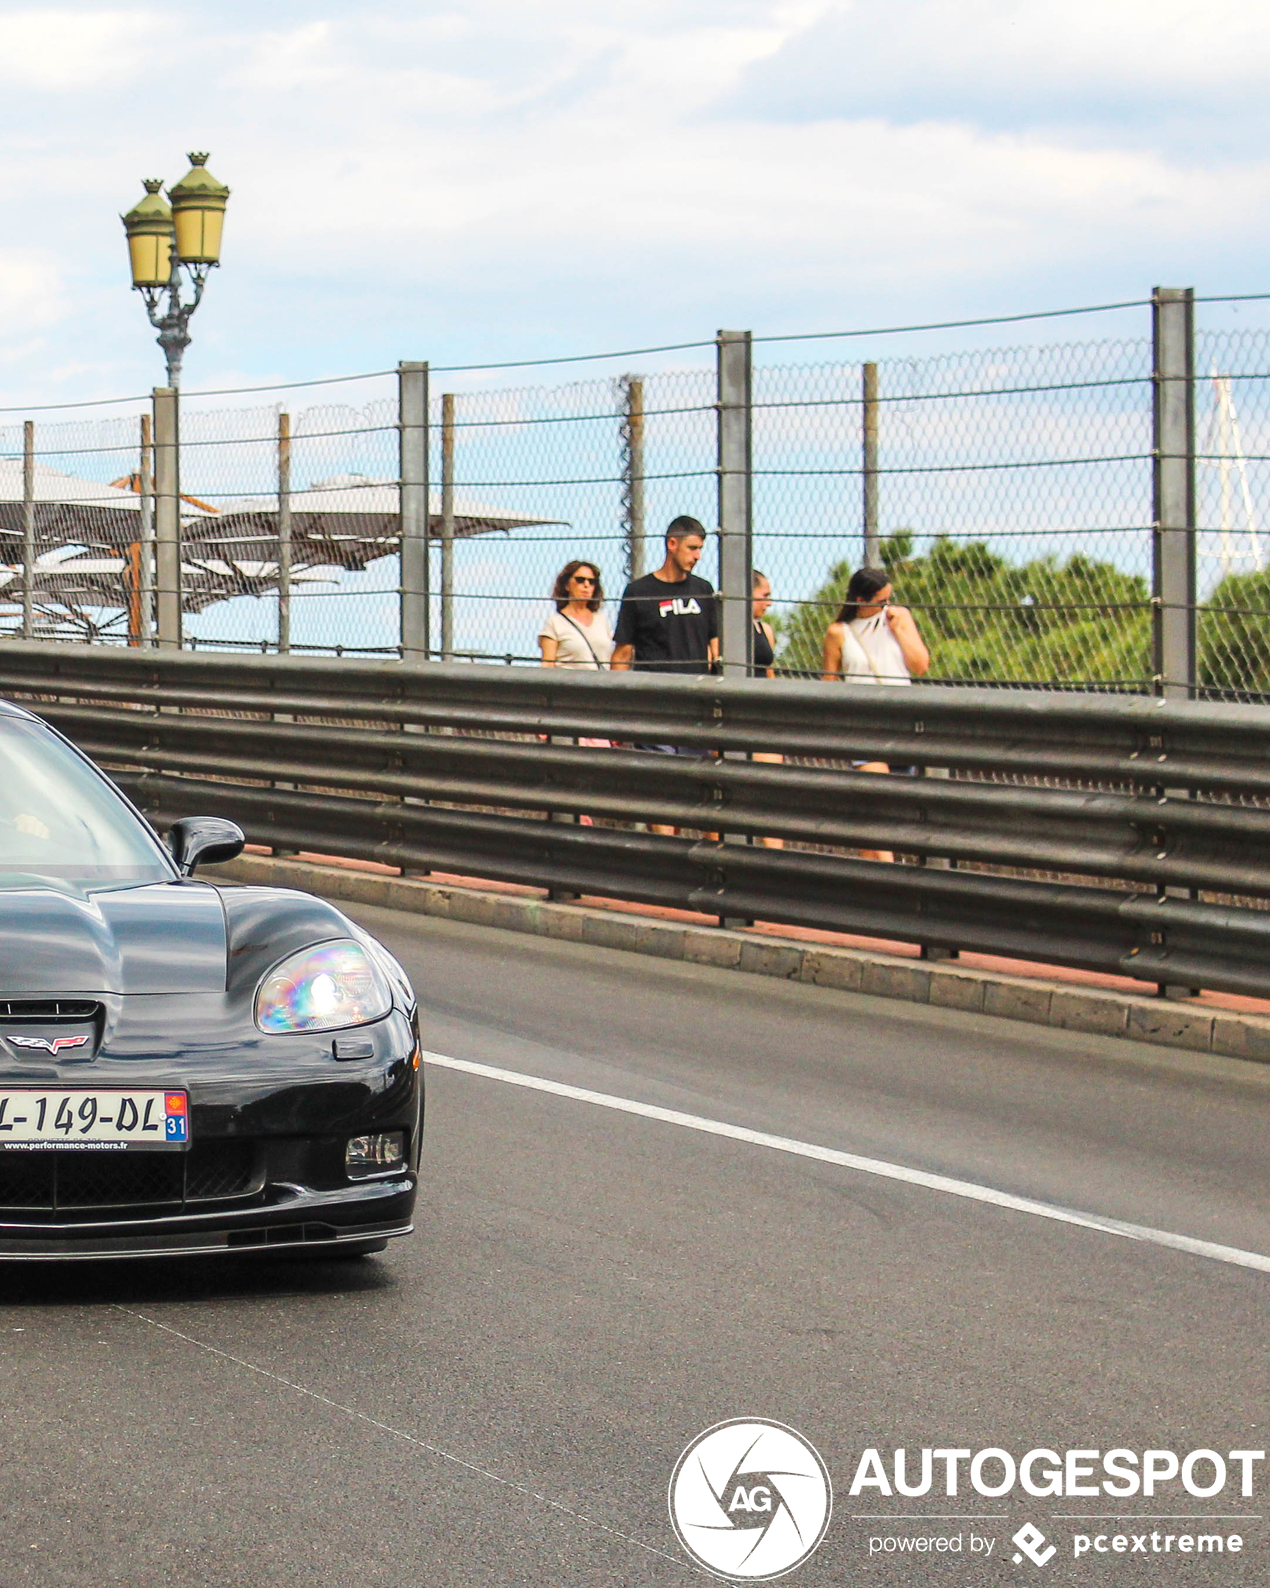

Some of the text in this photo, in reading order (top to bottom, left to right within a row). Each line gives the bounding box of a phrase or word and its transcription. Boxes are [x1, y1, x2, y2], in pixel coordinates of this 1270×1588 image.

[658, 597, 702, 618] FILA
[167, 1117, 185, 1135] 31
[4, 1141, 128, 1151] www.performance-motors.fr
